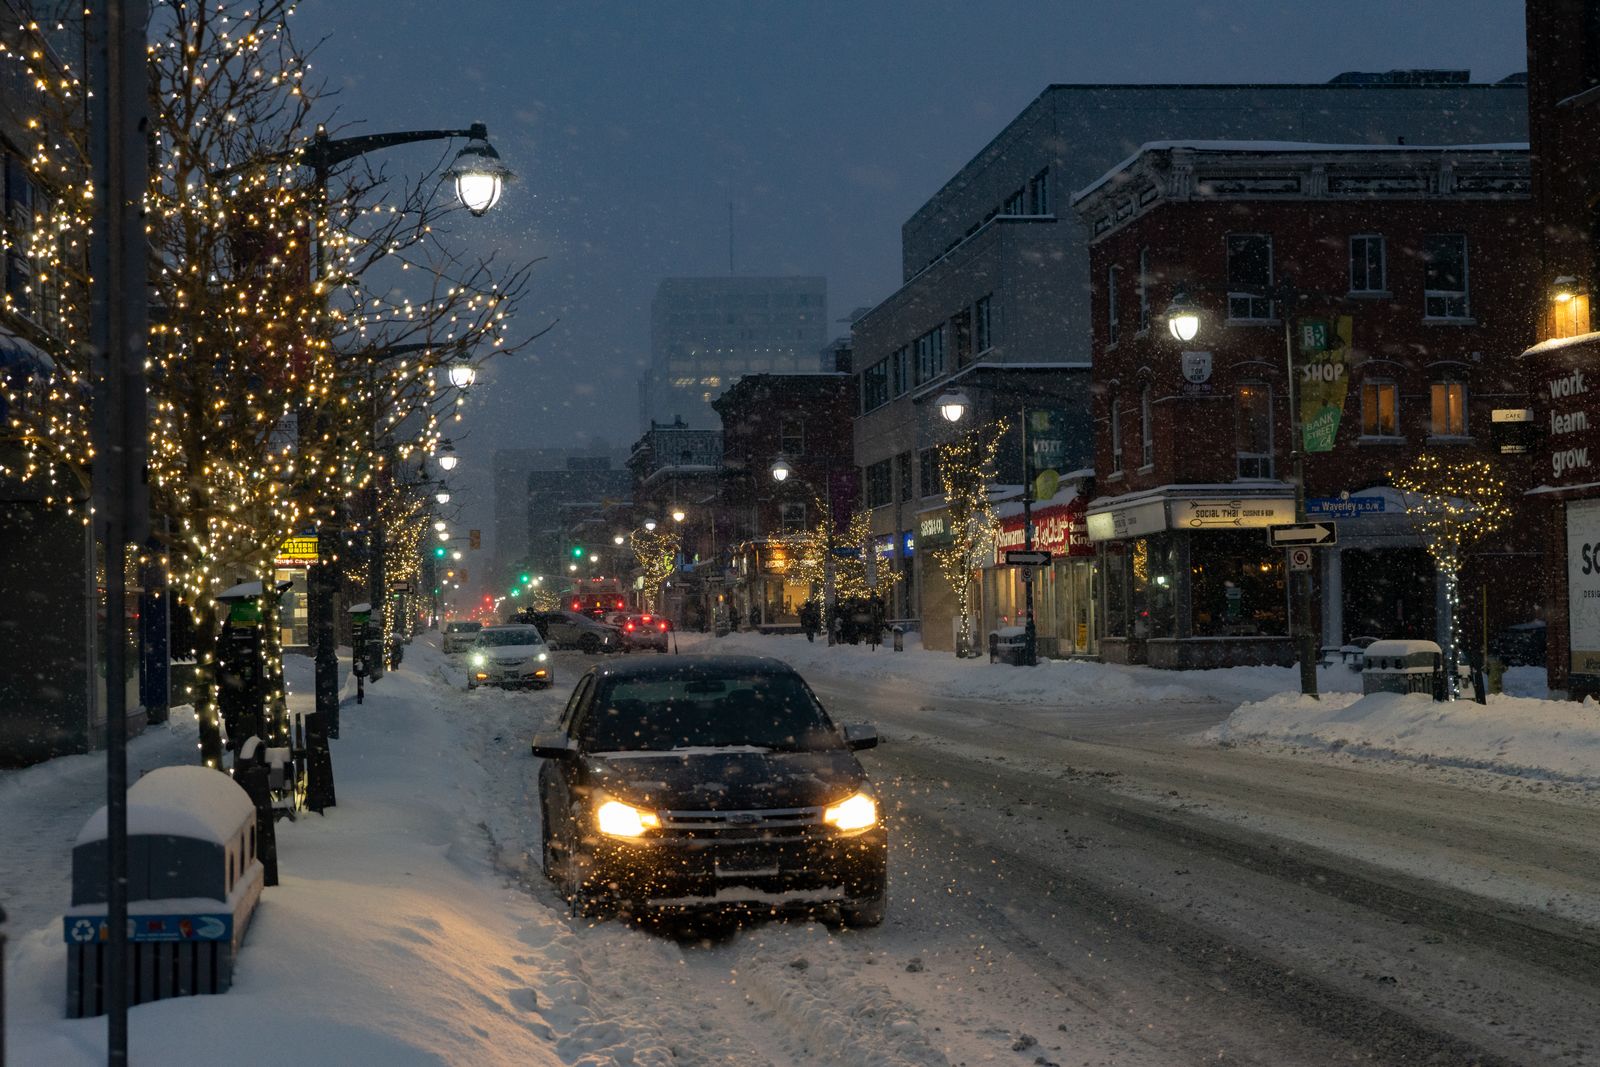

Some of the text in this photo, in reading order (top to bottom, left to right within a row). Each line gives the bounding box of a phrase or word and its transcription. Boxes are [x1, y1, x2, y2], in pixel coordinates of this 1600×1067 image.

[1303, 362, 1344, 382] SHOP
[1550, 367, 1589, 399] work.
[1306, 412, 1334, 431] BANK
[1307, 423, 1335, 440] STREET
[1550, 409, 1591, 435] learn.
[1552, 447, 1592, 479] grow.
[1321, 500, 1357, 514] Waverley
